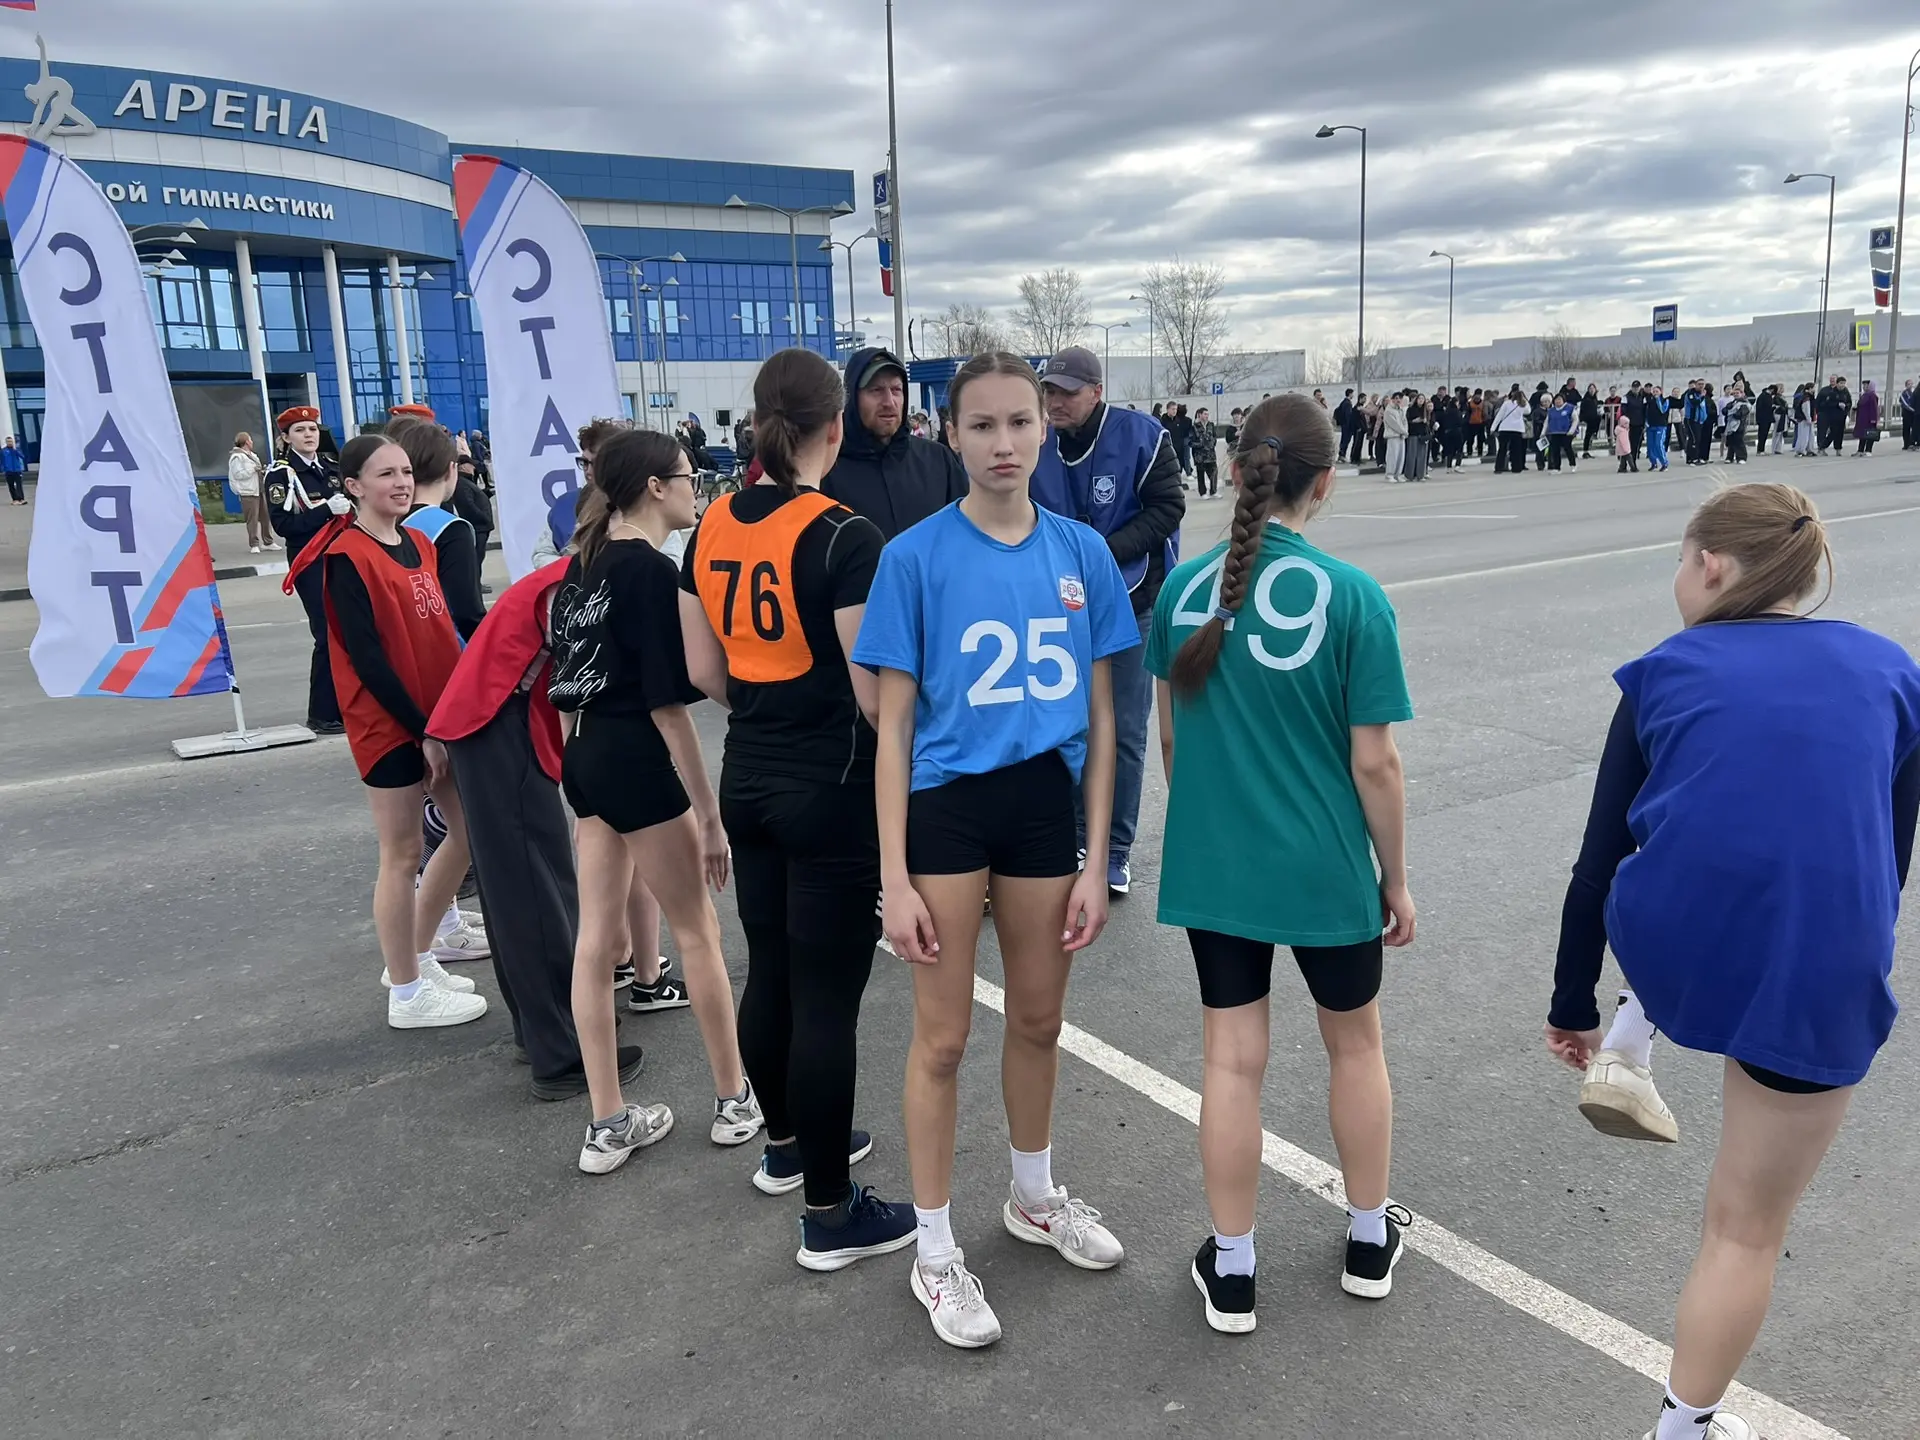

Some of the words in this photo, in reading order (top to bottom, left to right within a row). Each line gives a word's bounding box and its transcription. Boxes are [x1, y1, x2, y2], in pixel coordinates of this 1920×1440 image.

[113, 79, 329, 144] АРЕНА
[98, 180, 148, 204] ОЙ
[162, 186, 335, 221] ГИМНАСТИКИ
[408, 571, 444, 619] 53
[710, 559, 785, 642] 76
[1172, 548, 1333, 671] 49
[960, 617, 1078, 707] 25
